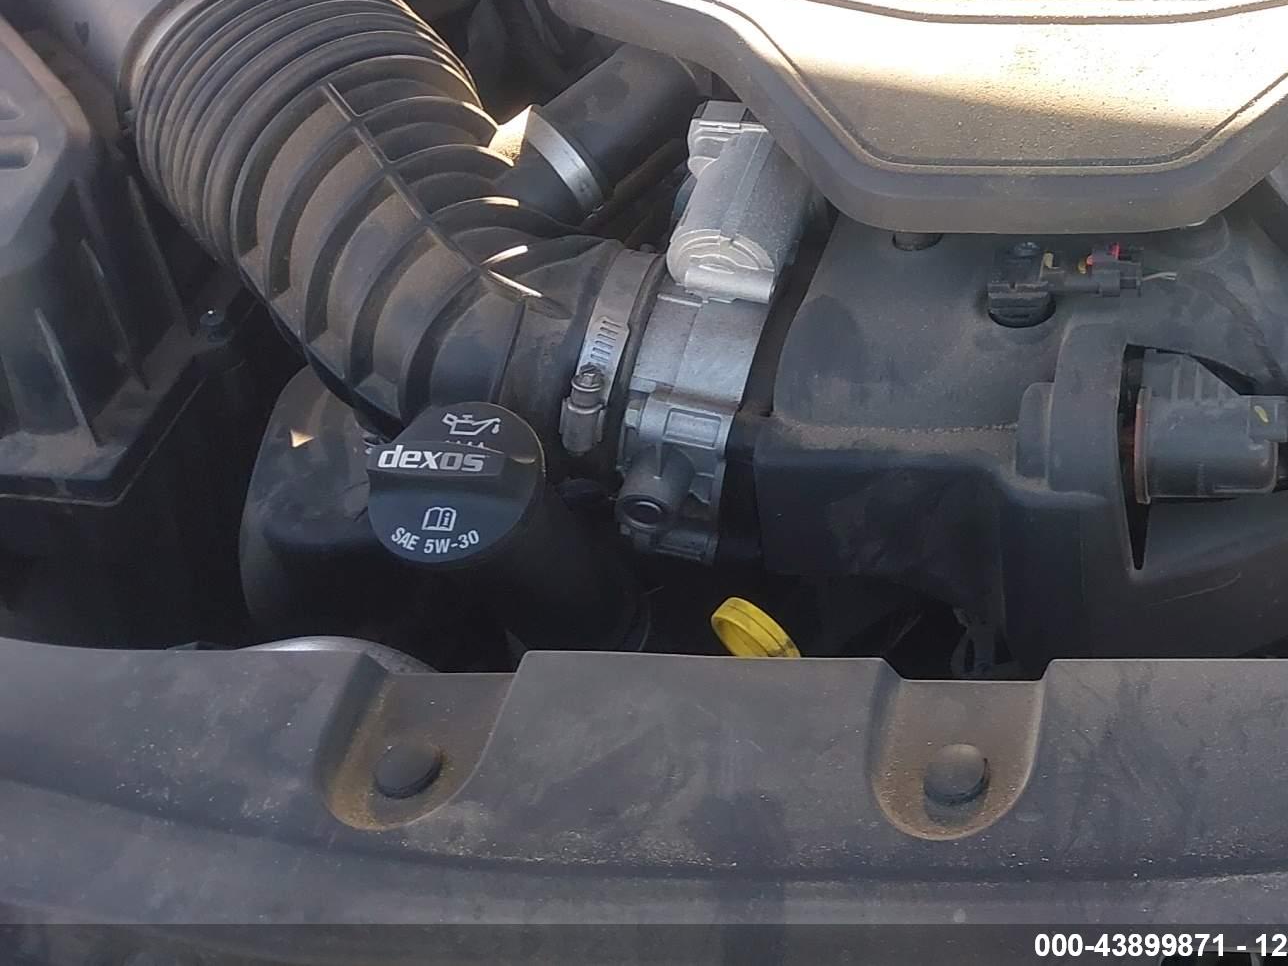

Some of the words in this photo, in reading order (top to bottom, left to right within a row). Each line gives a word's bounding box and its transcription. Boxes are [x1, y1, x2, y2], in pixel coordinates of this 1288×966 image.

[377, 444, 490, 472] dexos
[391, 527, 420, 551] SAE
[423, 530, 480, 554] 5W-30
